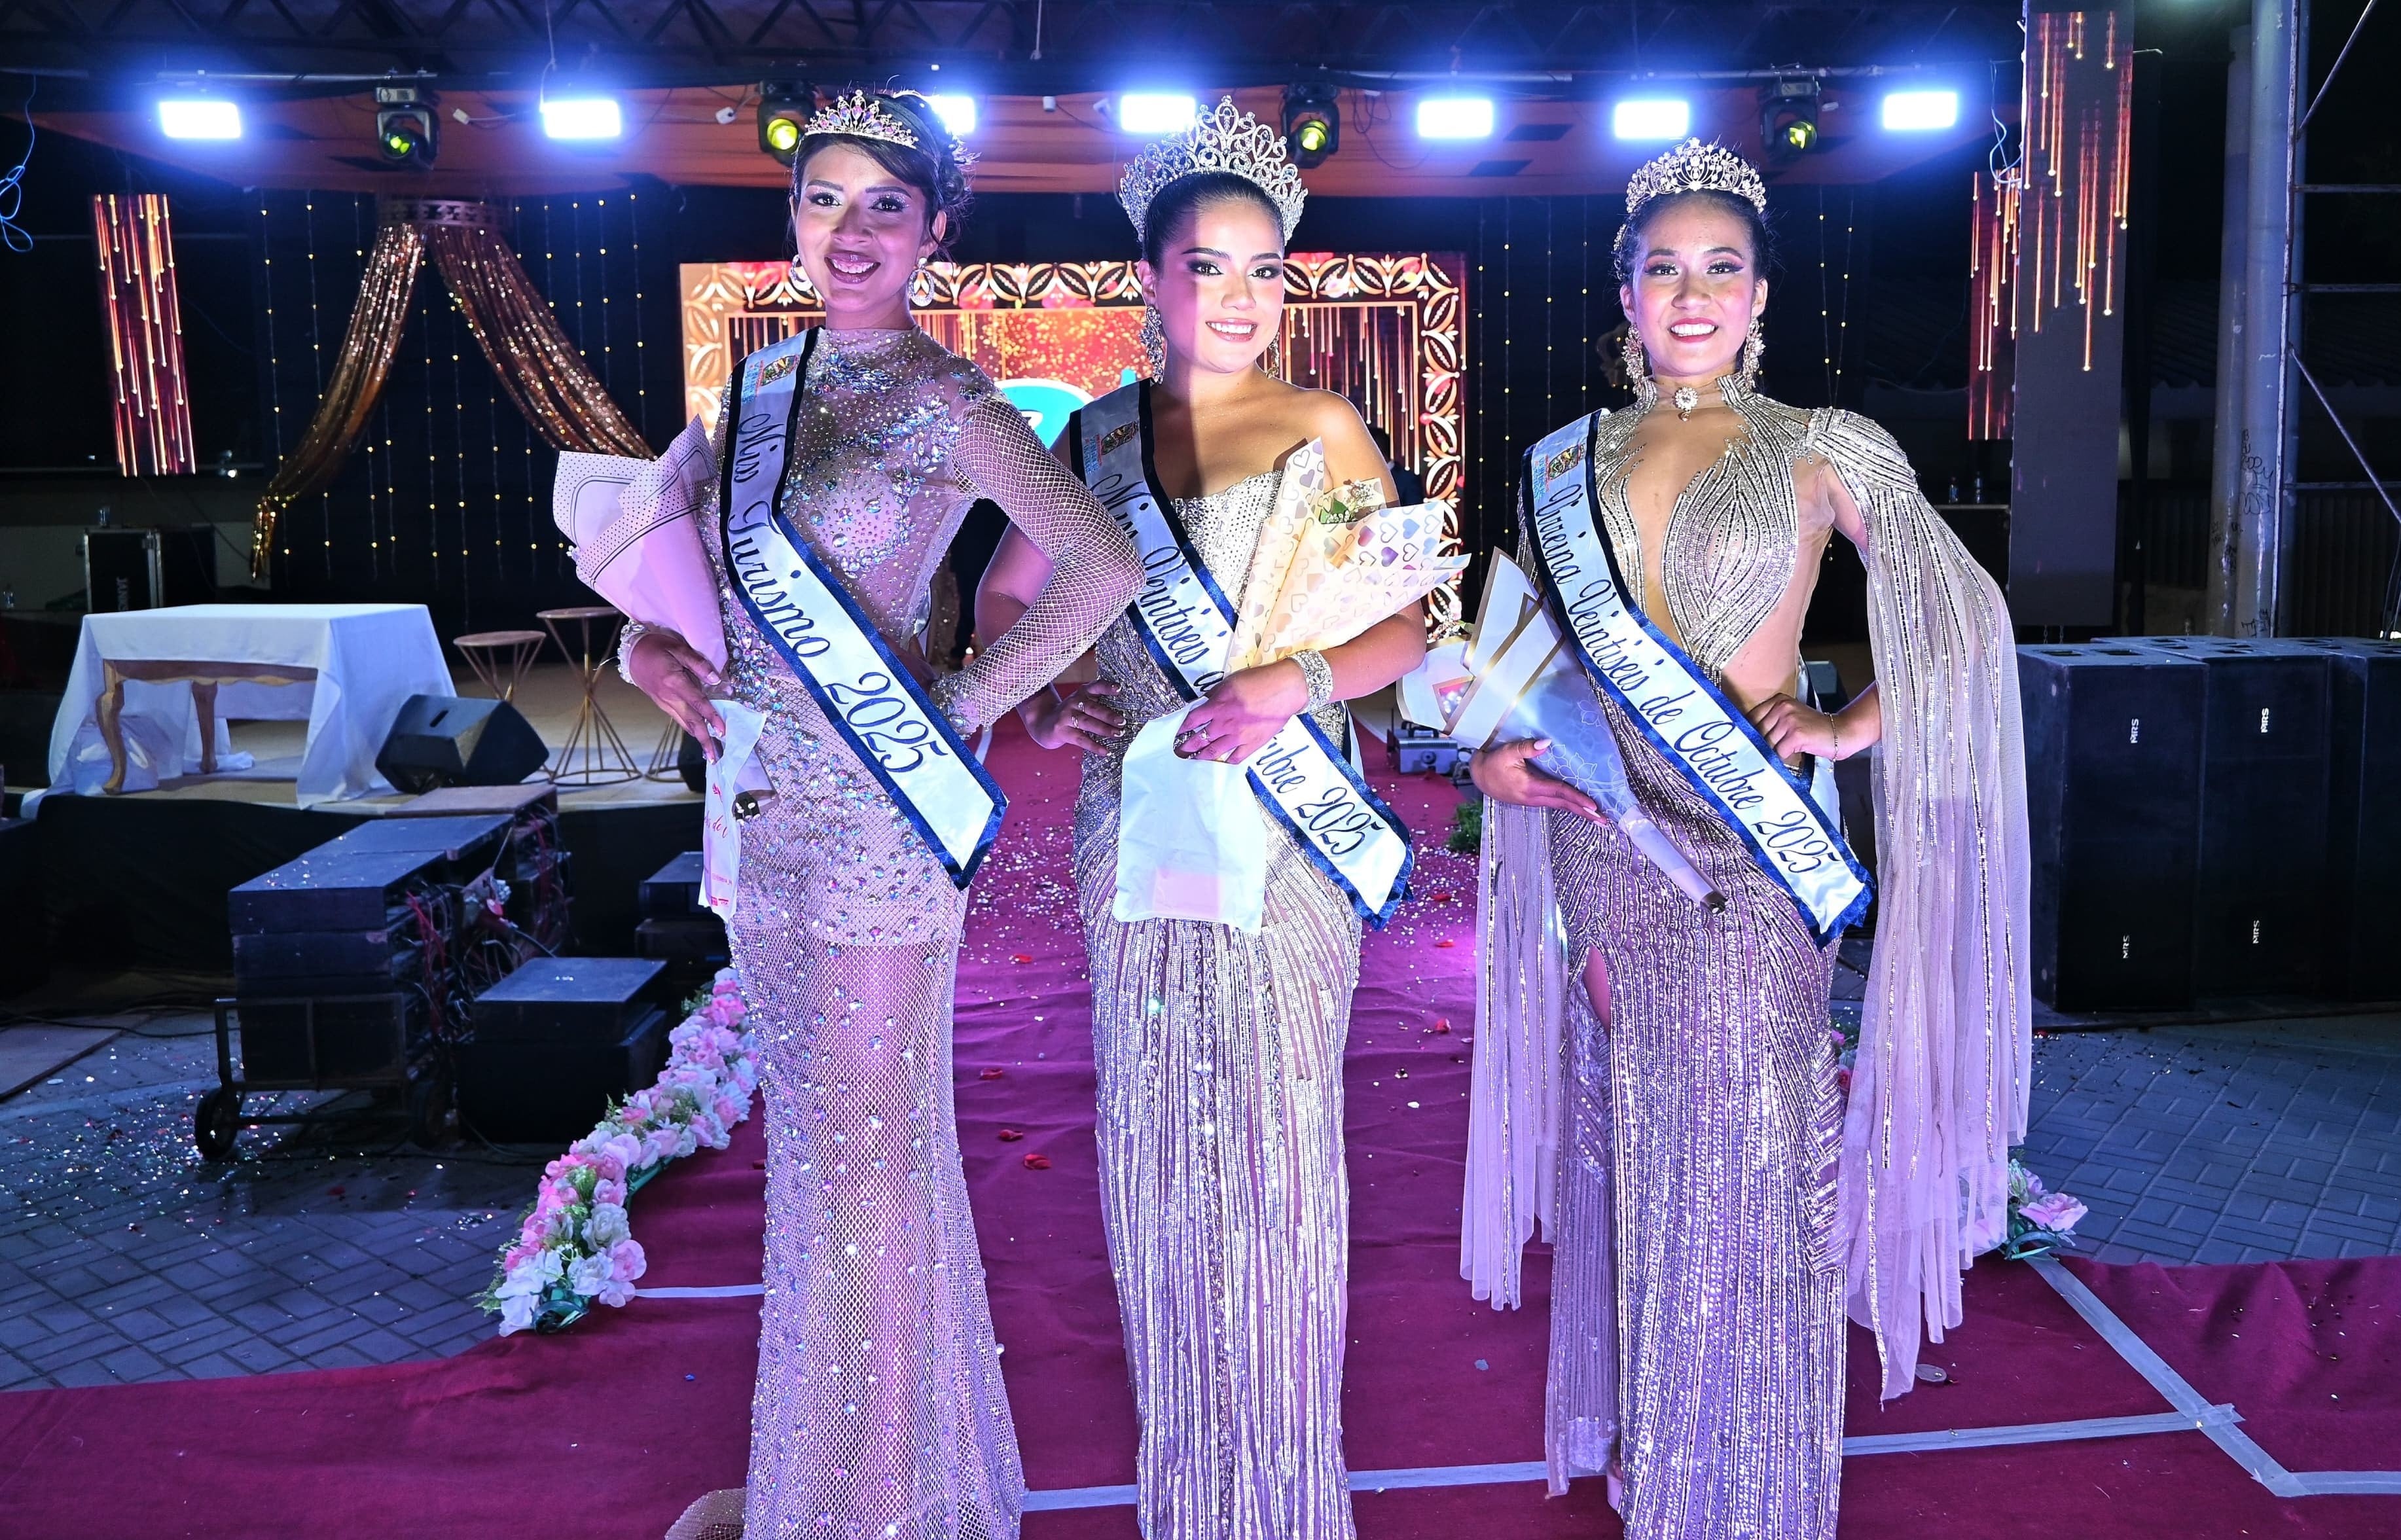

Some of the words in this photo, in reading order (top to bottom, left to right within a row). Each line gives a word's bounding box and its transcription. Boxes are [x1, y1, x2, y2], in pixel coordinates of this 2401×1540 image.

[732, 413, 786, 482] Miss
[728, 500, 830, 658] Turismo
[822, 672, 948, 773] 2025
[1138, 546, 1227, 665] Veintiseis
[1292, 787, 1386, 855] 2025
[1535, 484, 1587, 585] Virreina
[1568, 579, 1665, 691] Veintiseis
[1639, 690, 1696, 725] de
[1674, 721, 1765, 810] Octubre
[1751, 810, 1841, 873] 2025
[2260, 707, 2269, 733] MRS
[2130, 718, 2139, 743] MRS
